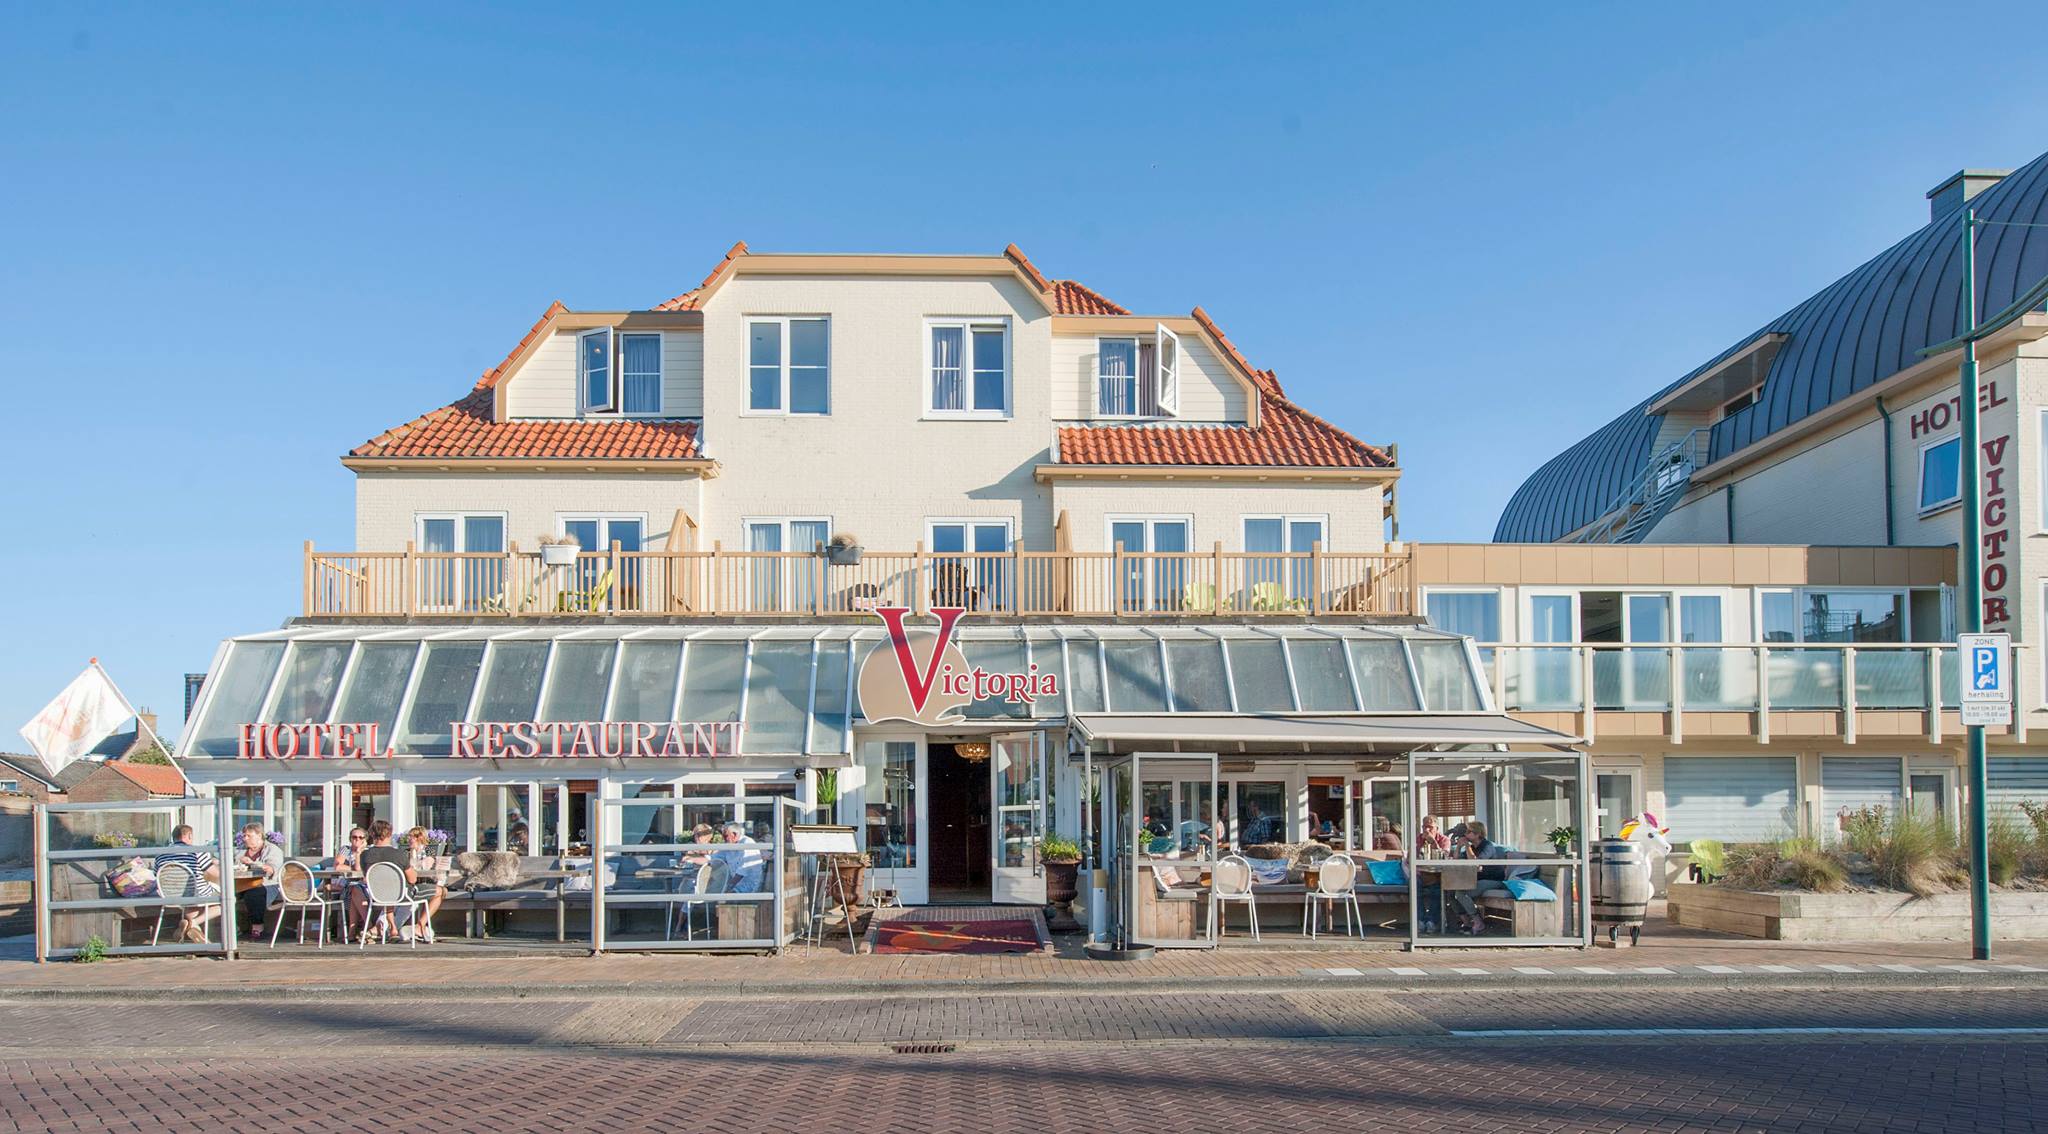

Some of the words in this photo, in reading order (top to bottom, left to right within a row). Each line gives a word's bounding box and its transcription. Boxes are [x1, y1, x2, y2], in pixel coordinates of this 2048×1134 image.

[1911, 381, 2008, 439] HOTEL
[1982, 435, 2010, 634] VICTOR
[1977, 649, 1993, 673] P
[236, 721, 393, 760] HOTEL
[449, 721, 747, 758] RESTAURANT
